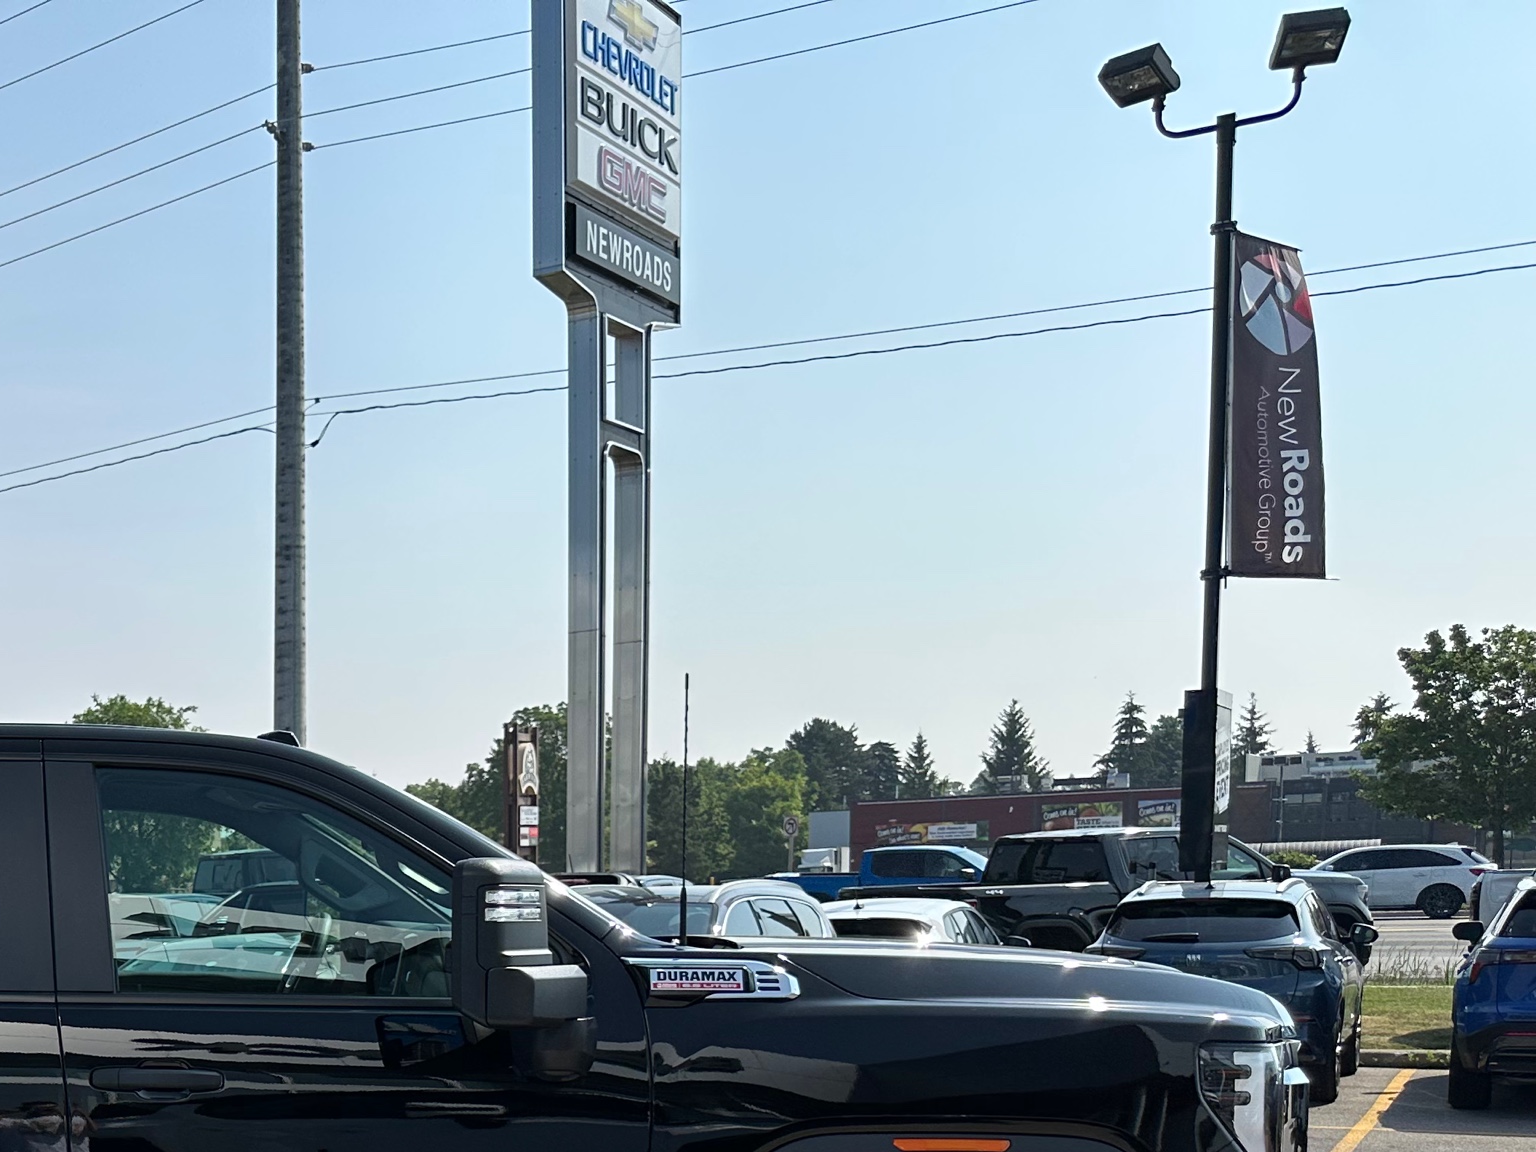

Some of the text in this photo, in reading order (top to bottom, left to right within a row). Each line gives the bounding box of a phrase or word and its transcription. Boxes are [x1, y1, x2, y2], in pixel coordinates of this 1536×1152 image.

[581, 19, 678, 116] CHEVROLET
[581, 76, 678, 175] BUICK
[598, 143, 667, 224] GMC
[586, 220, 672, 292] NEWROADS
[1255, 386, 1273, 490] Automotive
[1277, 367, 1311, 564] NewRoads
[657, 971, 737, 982] DURAMAX
